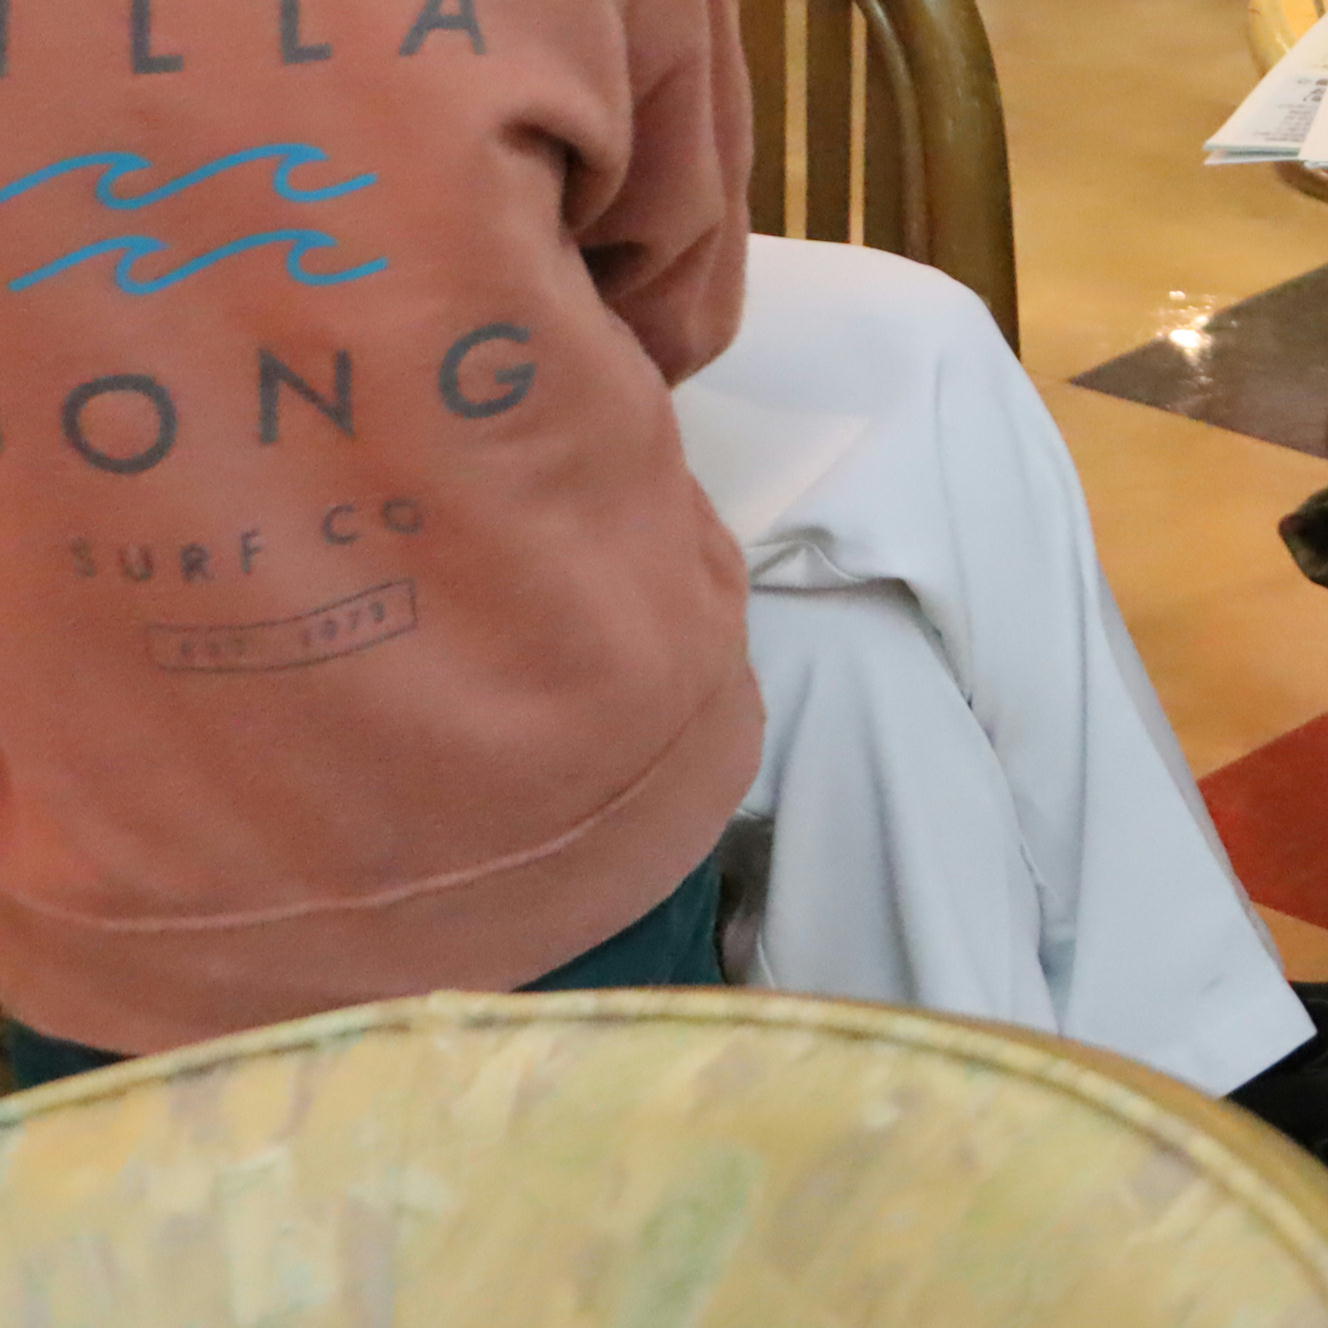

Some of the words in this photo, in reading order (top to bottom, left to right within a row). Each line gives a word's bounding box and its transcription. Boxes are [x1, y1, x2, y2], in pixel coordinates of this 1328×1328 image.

[0, 322, 539, 476] ONG
[70, 530, 267, 584] SURF
[322, 496, 428, 548] CO
